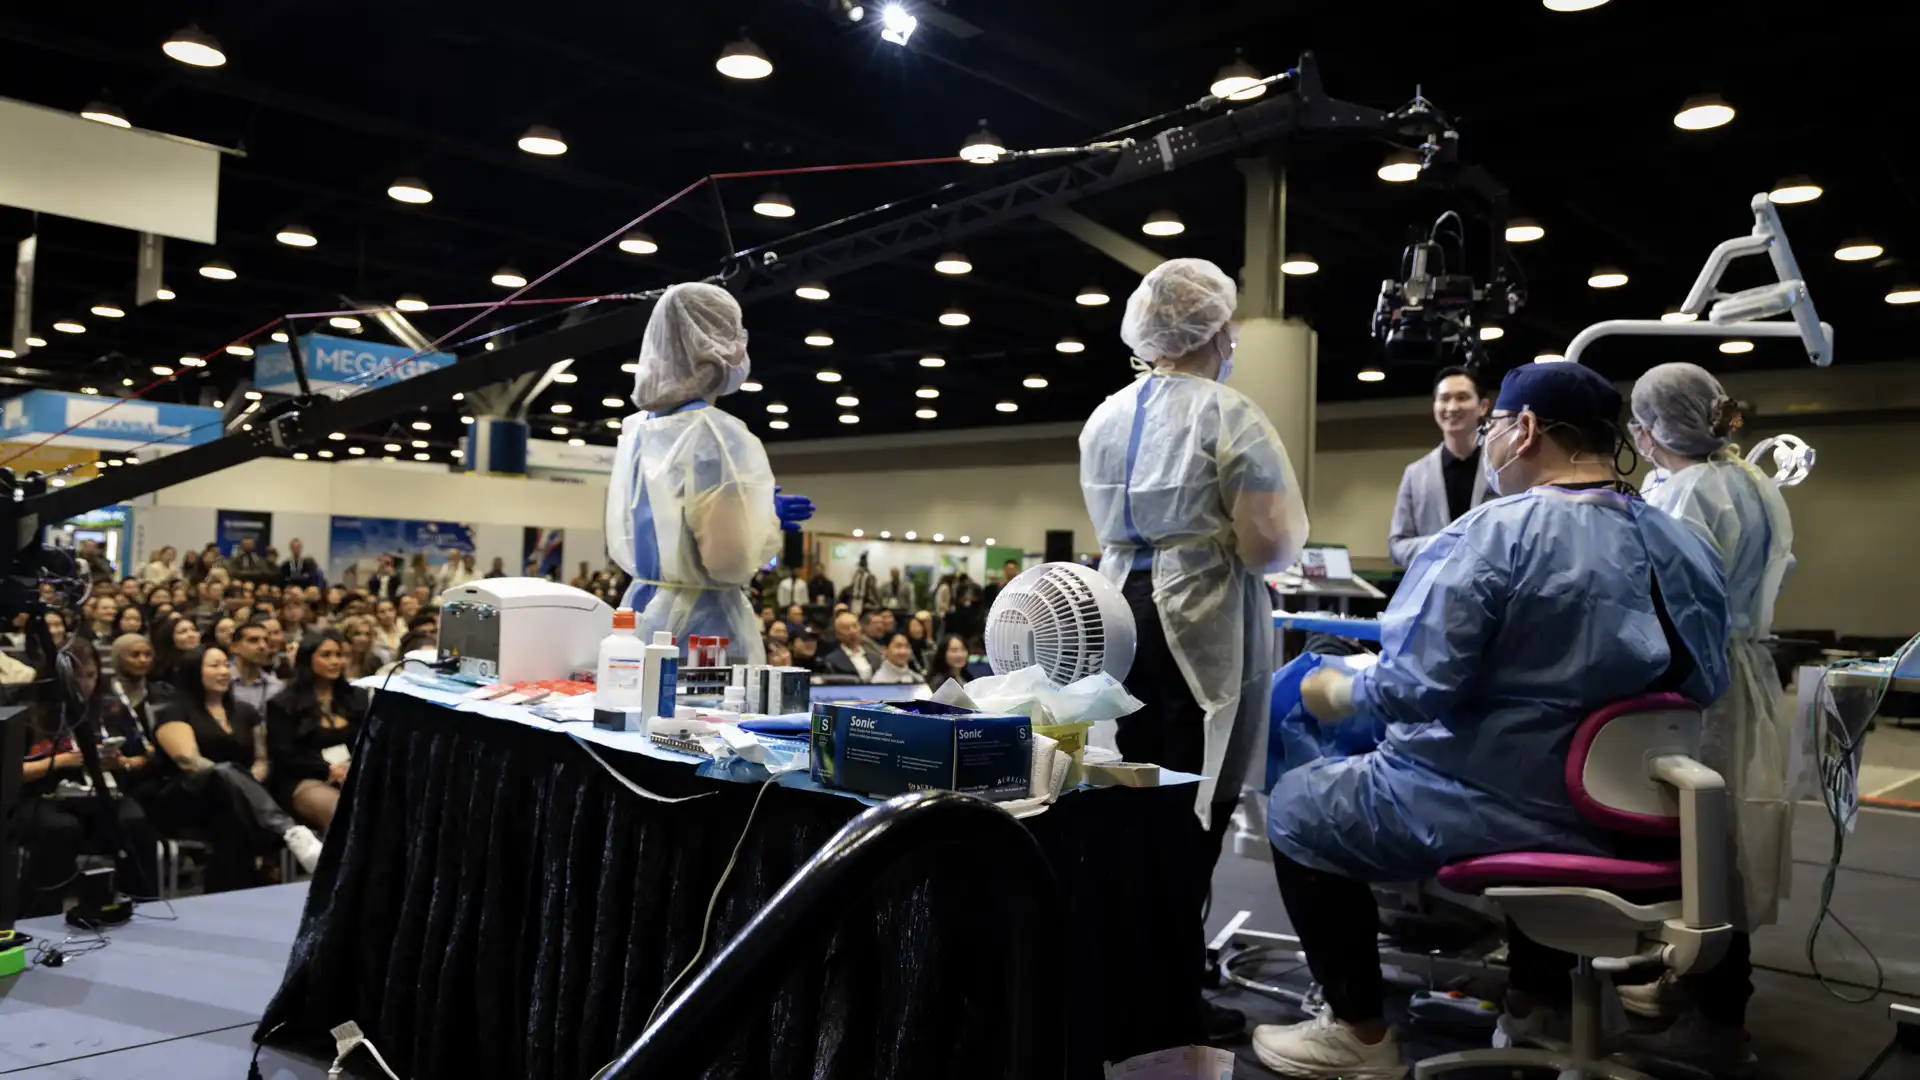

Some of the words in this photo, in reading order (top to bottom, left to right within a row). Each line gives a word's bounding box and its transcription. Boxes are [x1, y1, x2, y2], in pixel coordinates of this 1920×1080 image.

[821, 718, 829, 731] S
[850, 715, 876, 729] Sonic
[958, 728, 983, 740] Sonic
[1019, 727, 1026, 739] S
